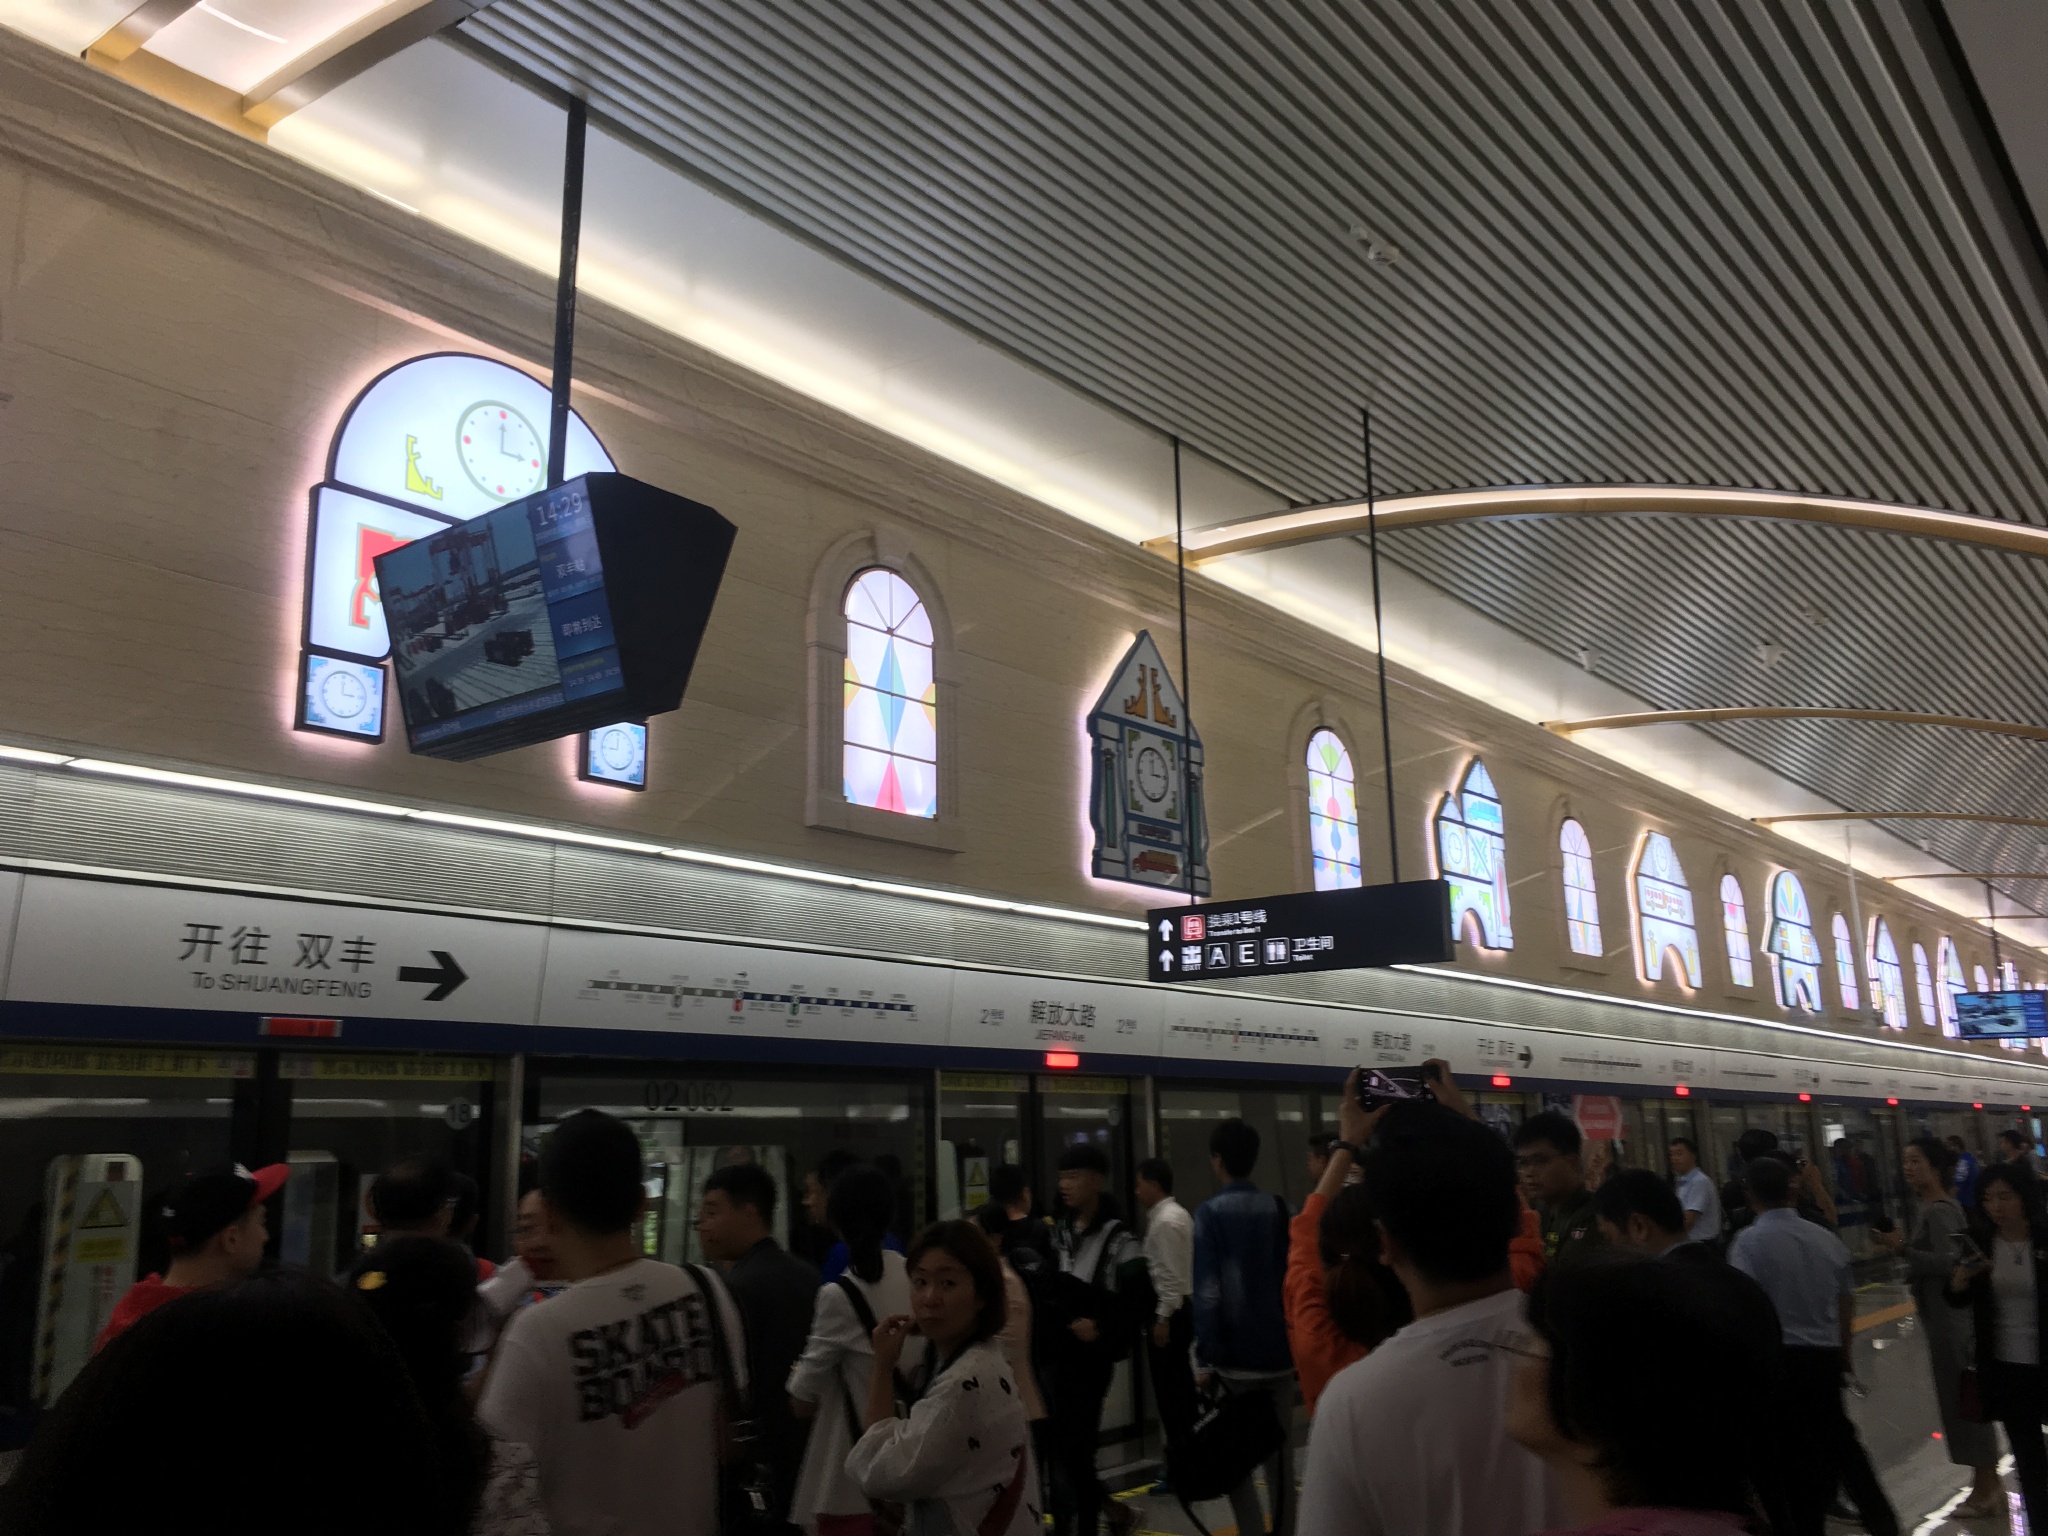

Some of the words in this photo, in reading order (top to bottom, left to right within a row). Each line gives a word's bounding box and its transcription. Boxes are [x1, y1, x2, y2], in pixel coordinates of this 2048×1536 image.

[536, 493, 584, 526] 14:29
[178, 922, 272, 966] 开往
[292, 932, 378, 974] 双丰
[1209, 947, 1227, 966] A
[1239, 944, 1256, 963] E
[1291, 935, 1335, 952] 卫生间
[190, 970, 216, 990] To
[217, 972, 373, 999] SHUANGFENG
[1030, 1000, 1097, 1028] 解放大路
